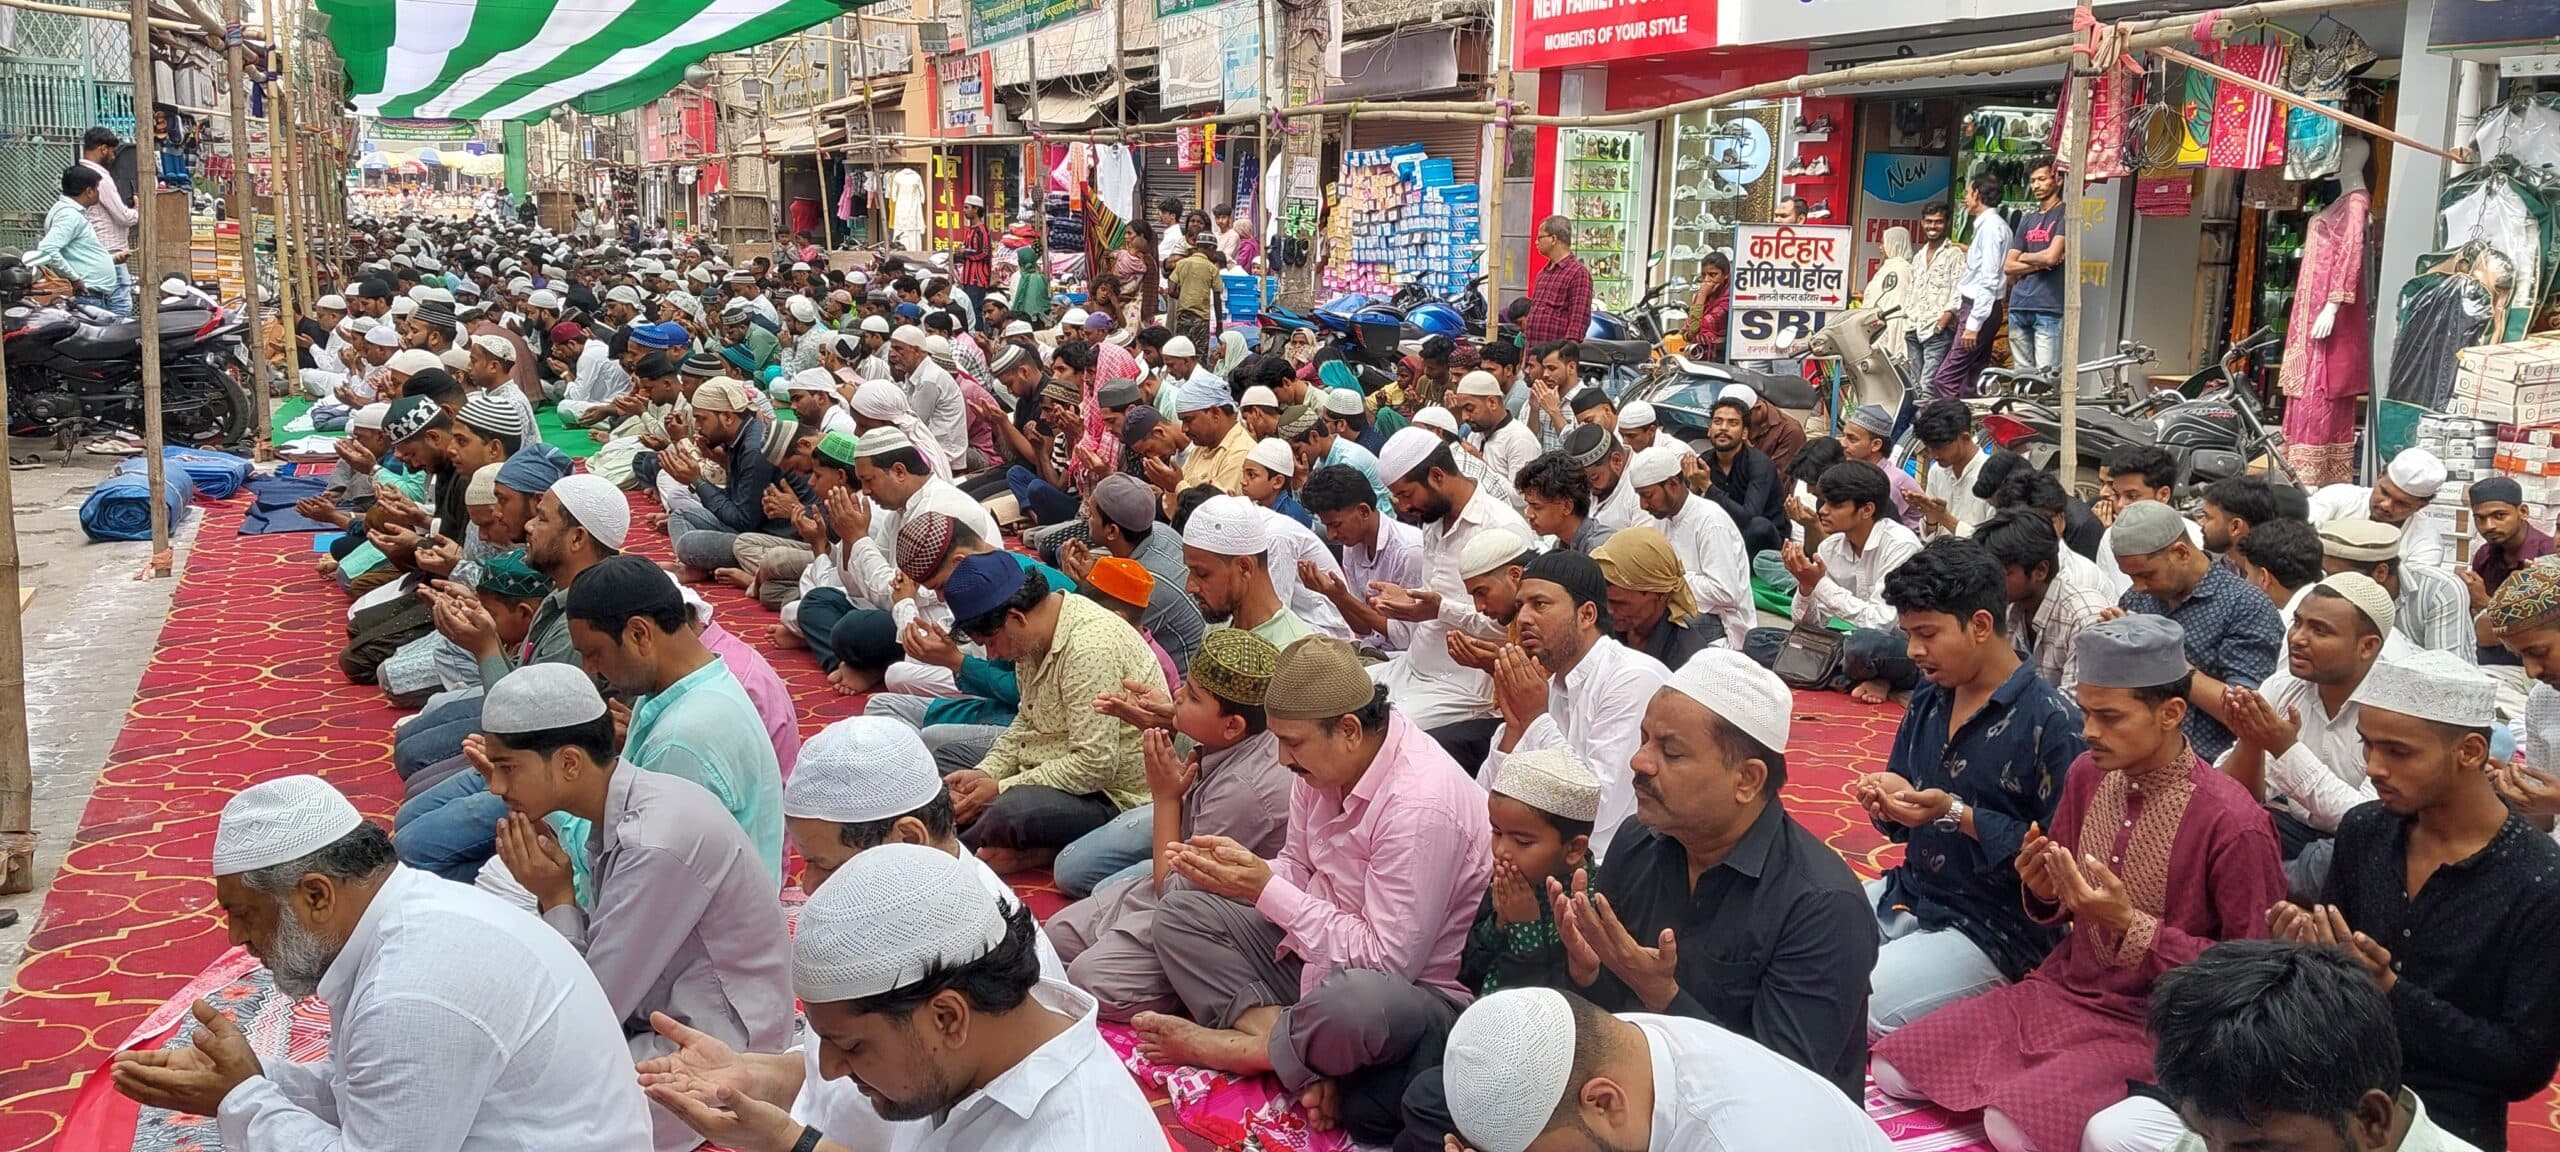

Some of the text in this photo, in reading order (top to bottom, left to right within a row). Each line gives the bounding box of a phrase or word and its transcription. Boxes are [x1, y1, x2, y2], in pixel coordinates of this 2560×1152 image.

[1532, 0, 1562, 20] NEW
[1544, 15, 1688, 51] MOMENTS OF YOUR STYLE
[1885, 157, 1928, 199] New
[1750, 226, 1835, 264] कटिहार
[1740, 310, 1826, 341] SBI
